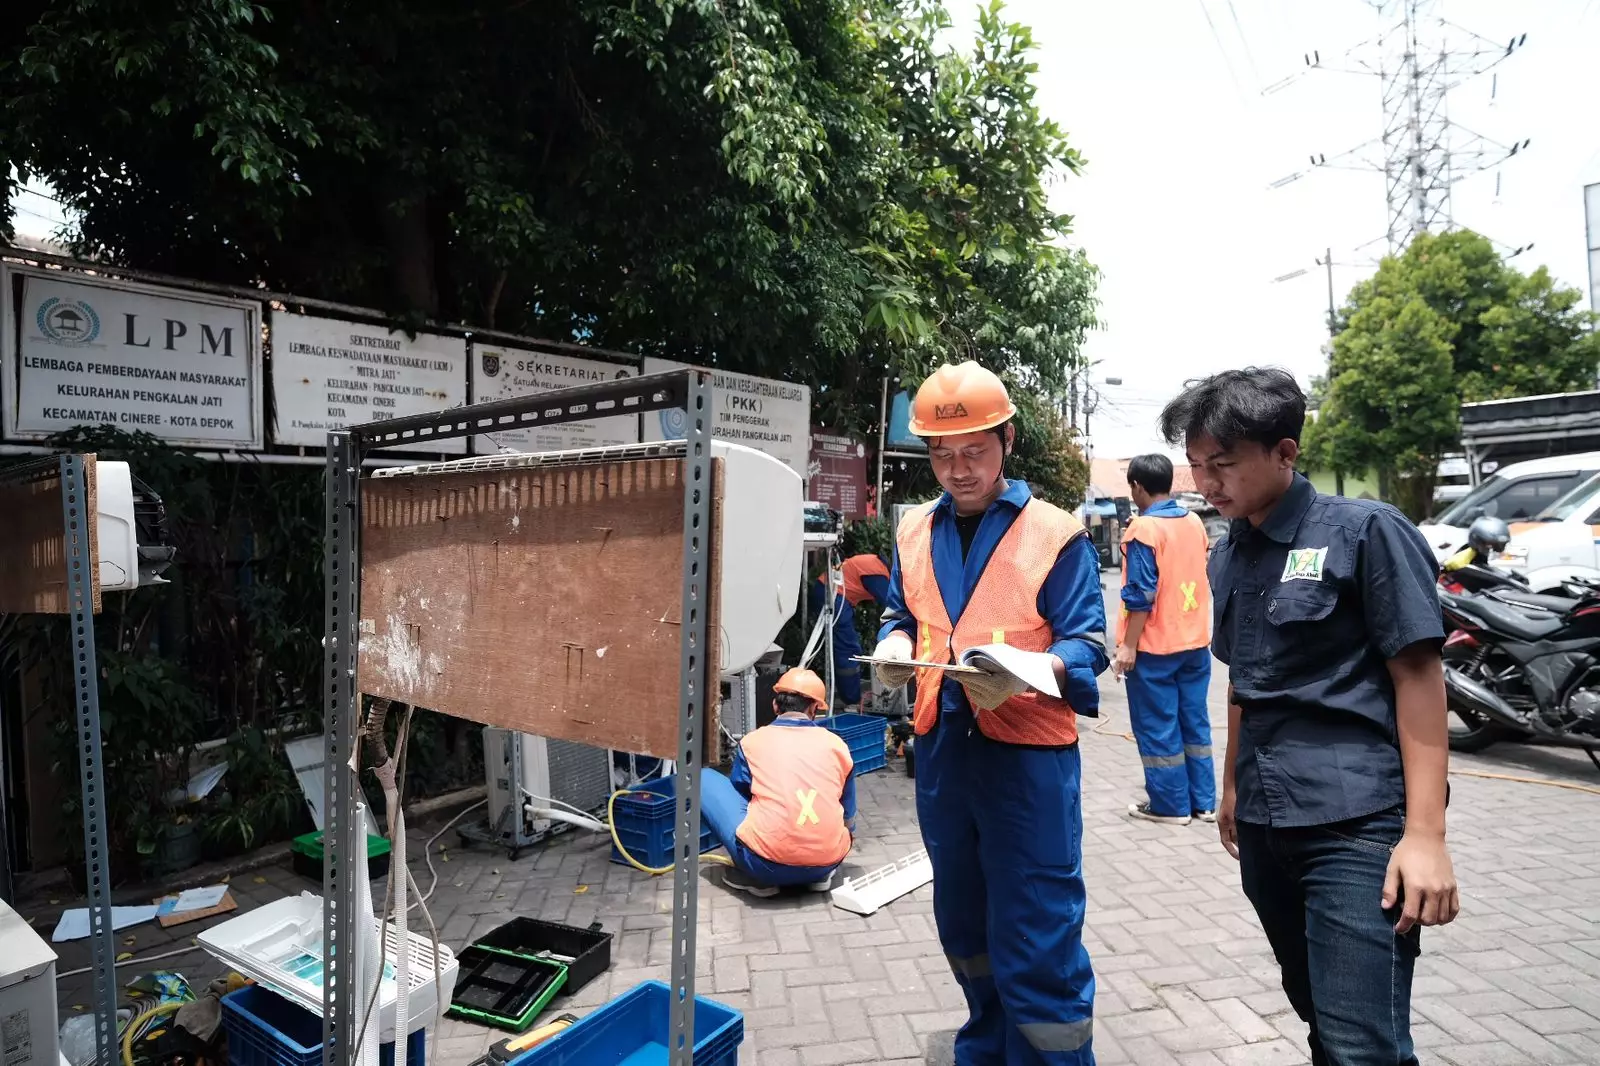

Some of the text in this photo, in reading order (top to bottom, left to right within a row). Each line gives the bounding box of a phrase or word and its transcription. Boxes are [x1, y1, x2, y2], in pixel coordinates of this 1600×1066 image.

[349, 334, 401, 349] SEKTRETARIAT
[289, 341, 327, 358] LEMBAGA
[328, 347, 382, 364] KESWADAYAAN
[383, 354, 428, 369] MASYARAKAT
[24, 356, 248, 388] LEMBAGA PEMBERDAYAAN MASYARAKAT
[517, 360, 605, 381] SEKRETARIAT
[327, 378, 425, 397] KELURAHAN PANGKALAN JATI
[513, 377, 540, 388] SATUAN
[726, 376, 737, 390] DAN
[738, 378, 778, 398] KESEJAHTERAAN
[778, 386, 802, 402] KELUARGA
[57, 385, 223, 407] KELURAHAN PENGKALAN JATI
[327, 393, 396, 408] KECAMATAN CINERE
[42, 407, 117, 422] KECAMATAN
[120, 413, 161, 425] CINERE
[170, 415, 198, 427] KOTA
[200, 417, 234, 430] DEPOK
[327, 408, 346, 419] KOTA
[719, 412, 770, 427] TIM PENGGERAK
[742, 430, 779, 442] PANGKALAN
[779, 434, 793, 443] JATI
